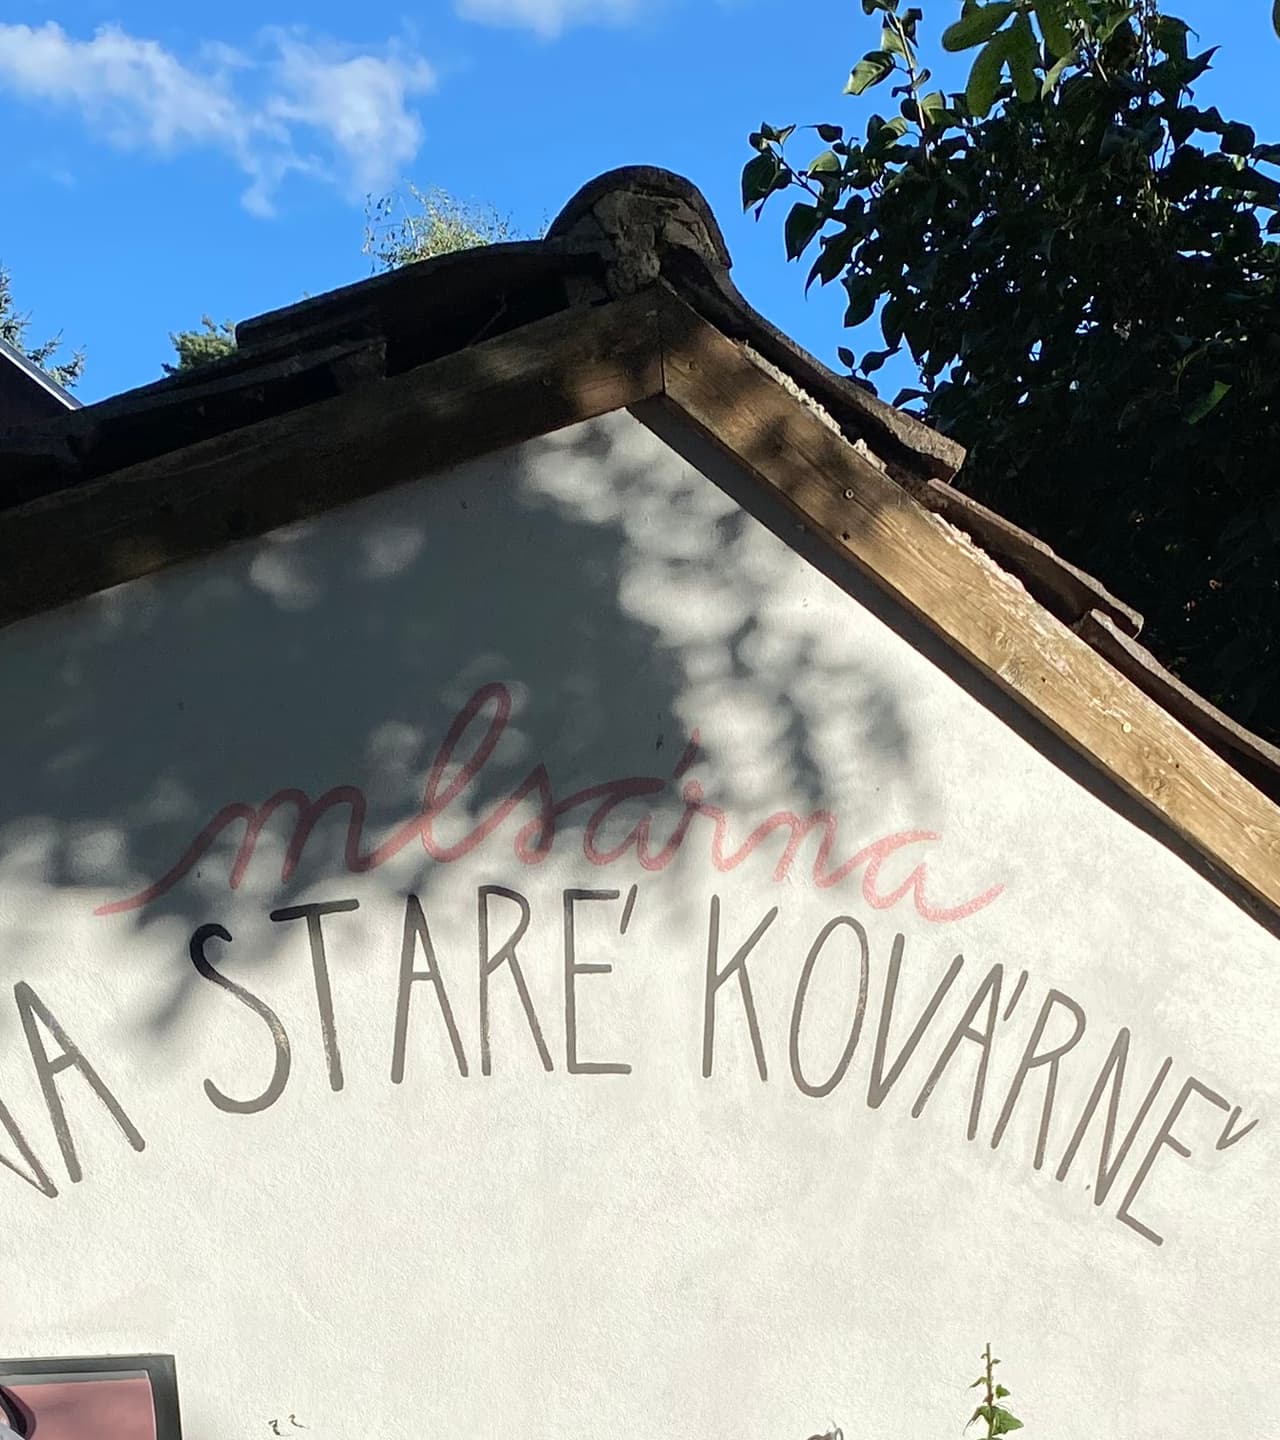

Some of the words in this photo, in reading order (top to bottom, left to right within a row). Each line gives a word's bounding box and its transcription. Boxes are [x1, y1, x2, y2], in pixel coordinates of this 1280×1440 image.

[93, 681, 1004, 923] mlsárna
[188, 884, 635, 1114] STARÉ
[701, 892, 1260, 1246] KOVÁRNĚ
